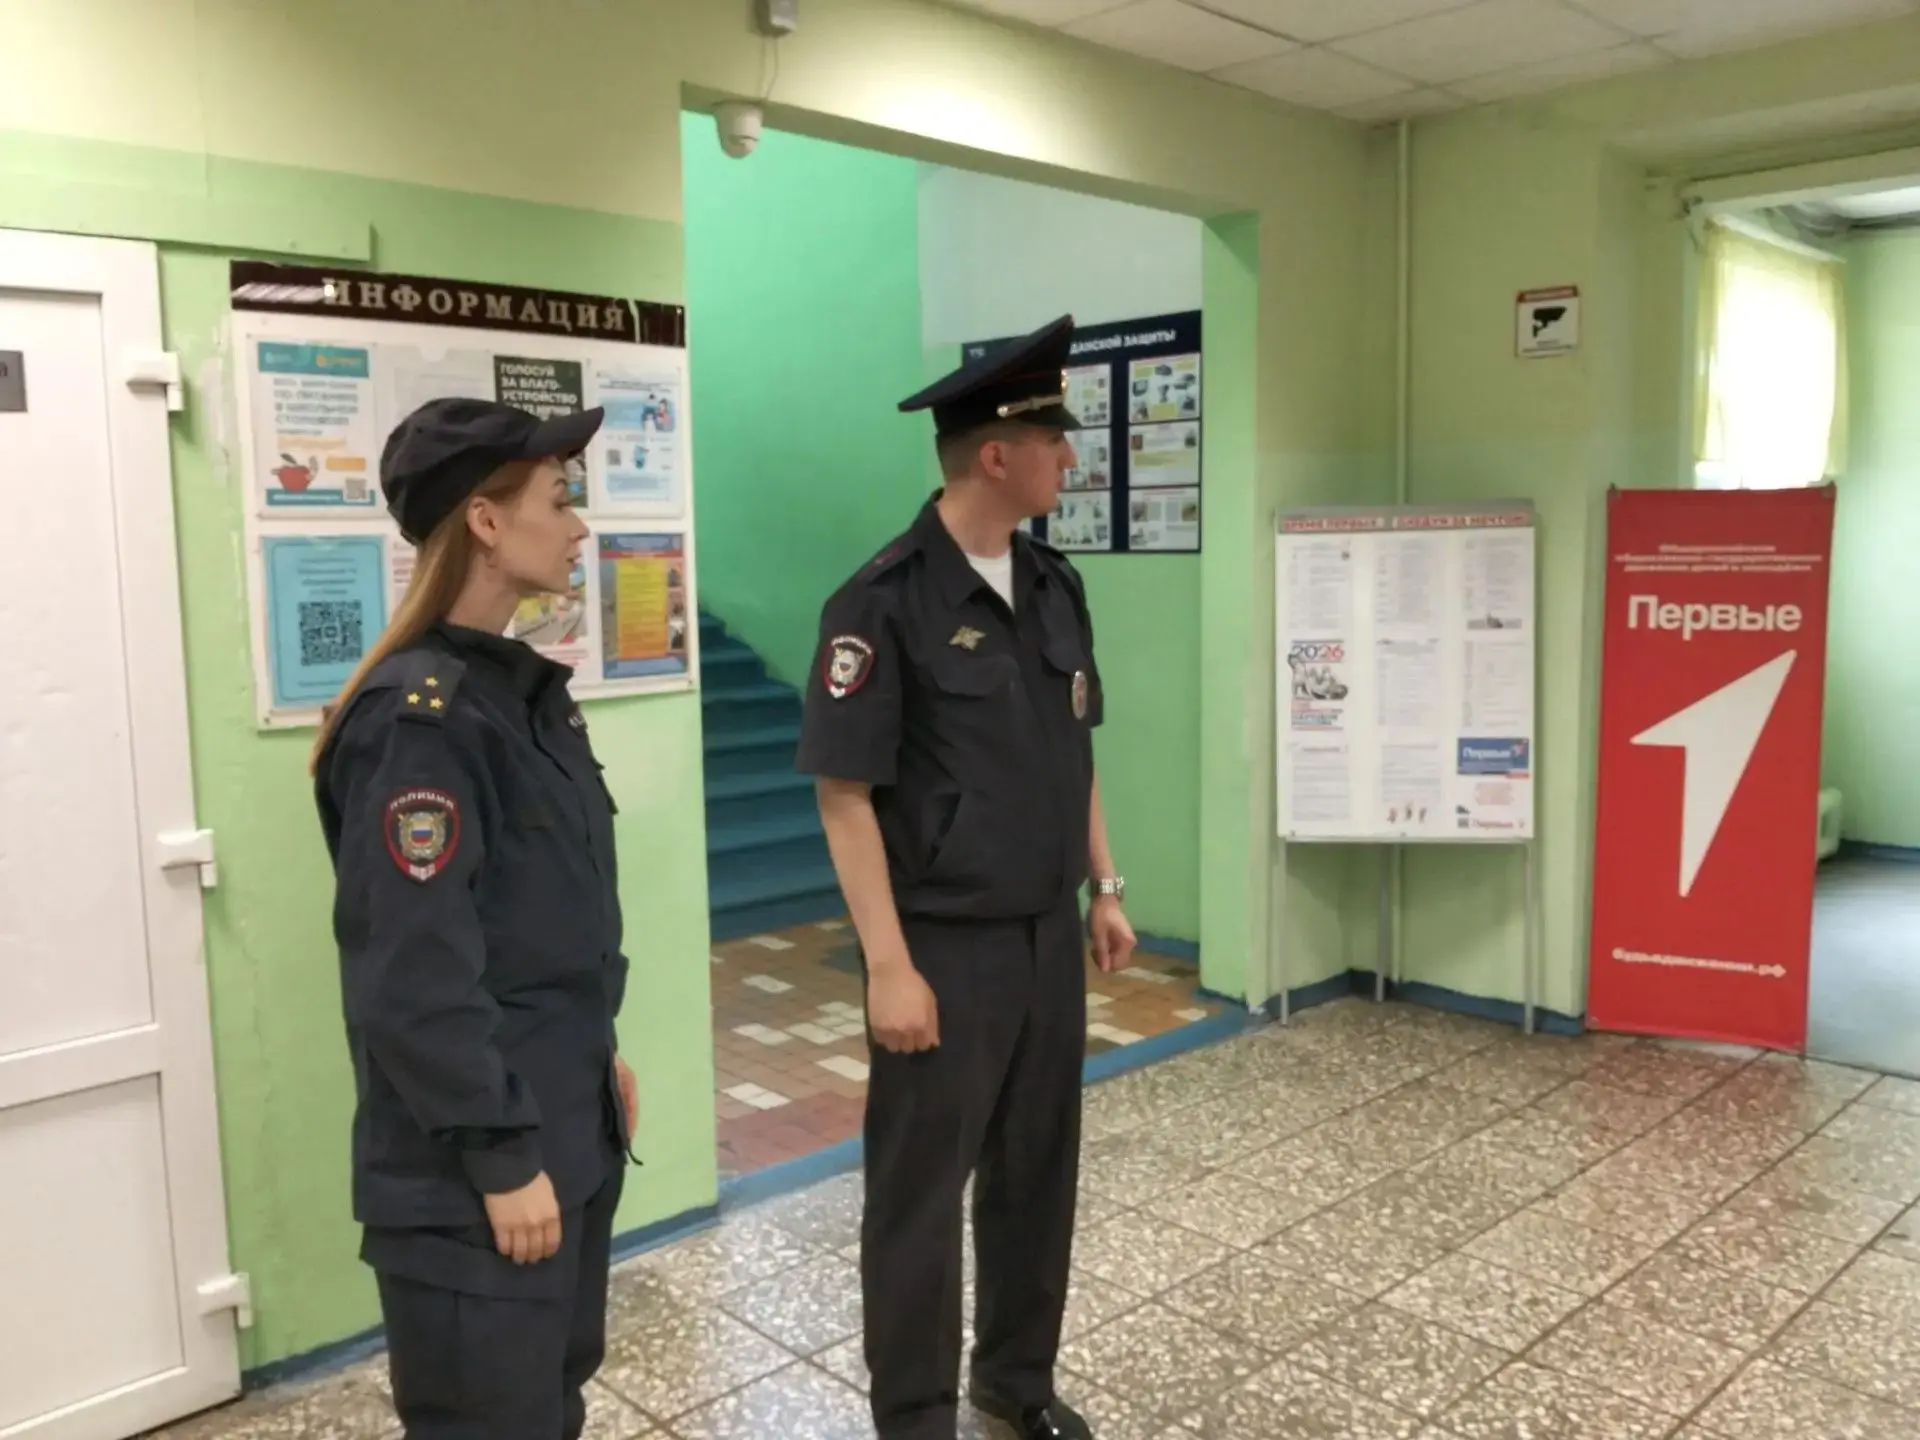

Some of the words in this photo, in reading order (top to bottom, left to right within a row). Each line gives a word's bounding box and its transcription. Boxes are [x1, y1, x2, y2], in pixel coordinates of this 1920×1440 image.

[322, 278, 625, 332] ИНФОРМАЦИЯ
[1069, 333, 1122, 355] ДАНСКОЙ
[1124, 328, 1176, 347] ЗАЩИТЫ
[500, 363, 555, 377] ГОЛОСУЙ
[501, 376, 517, 388] ЗА
[502, 390, 578, 405] УСТРОЙСТВО
[1628, 594, 1803, 642] Первые
[1292, 644, 1345, 661] 2026
